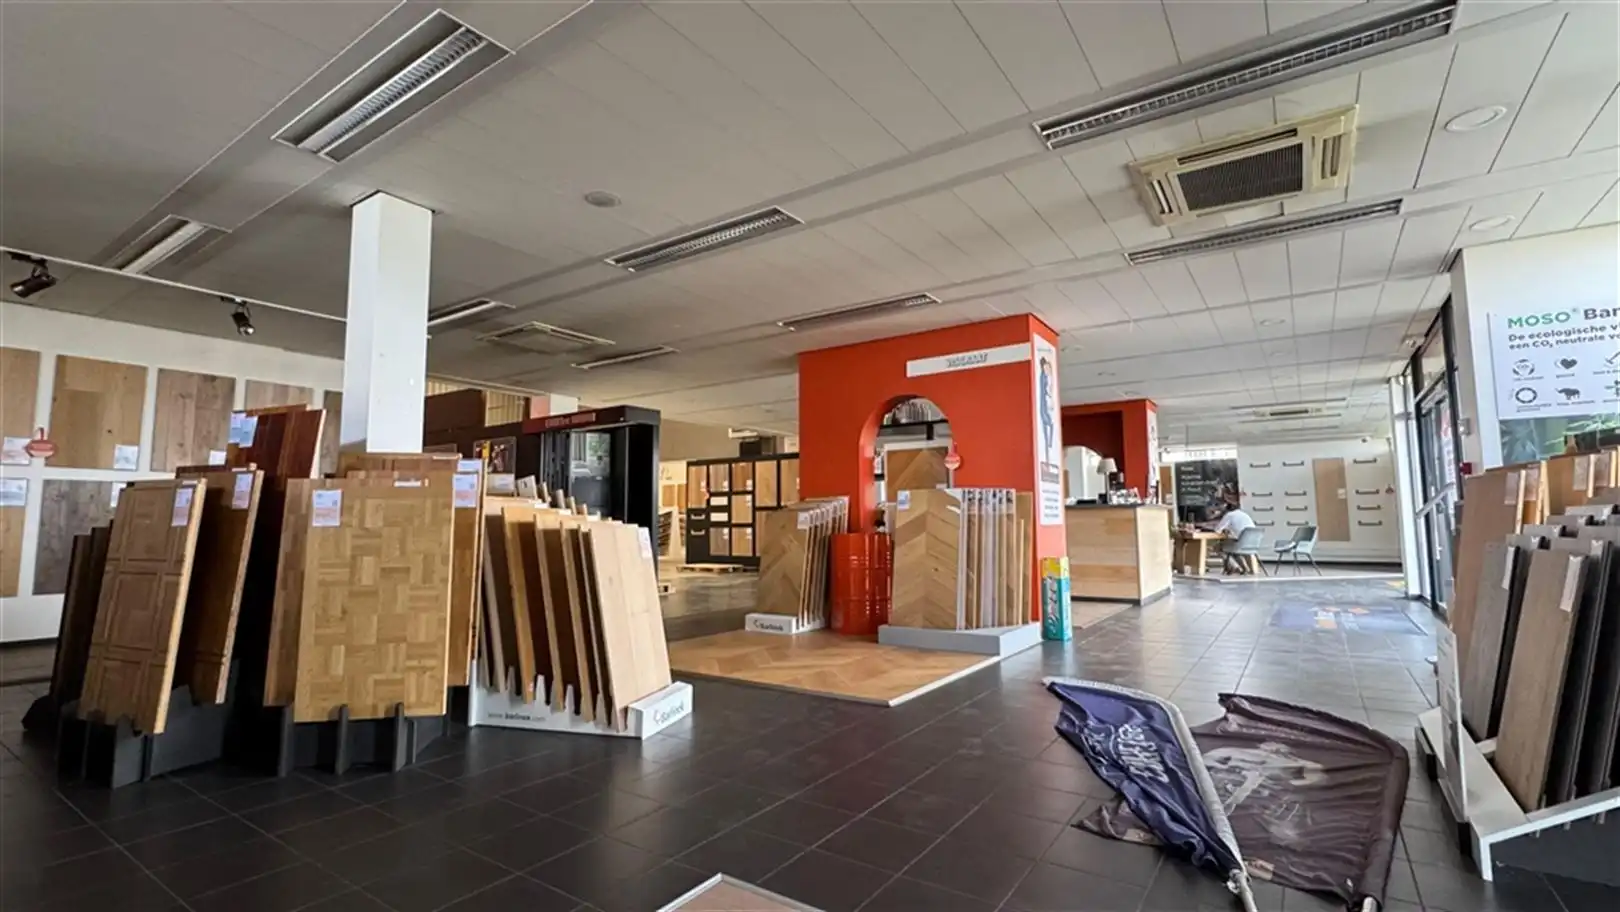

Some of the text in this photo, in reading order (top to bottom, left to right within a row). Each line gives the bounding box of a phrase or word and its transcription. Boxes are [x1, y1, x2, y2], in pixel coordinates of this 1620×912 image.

[1508, 333, 1525, 342] De
[1528, 325, 1607, 339] ecologische
[1508, 342, 1530, 350] een
[1555, 333, 1605, 345] neutrale
